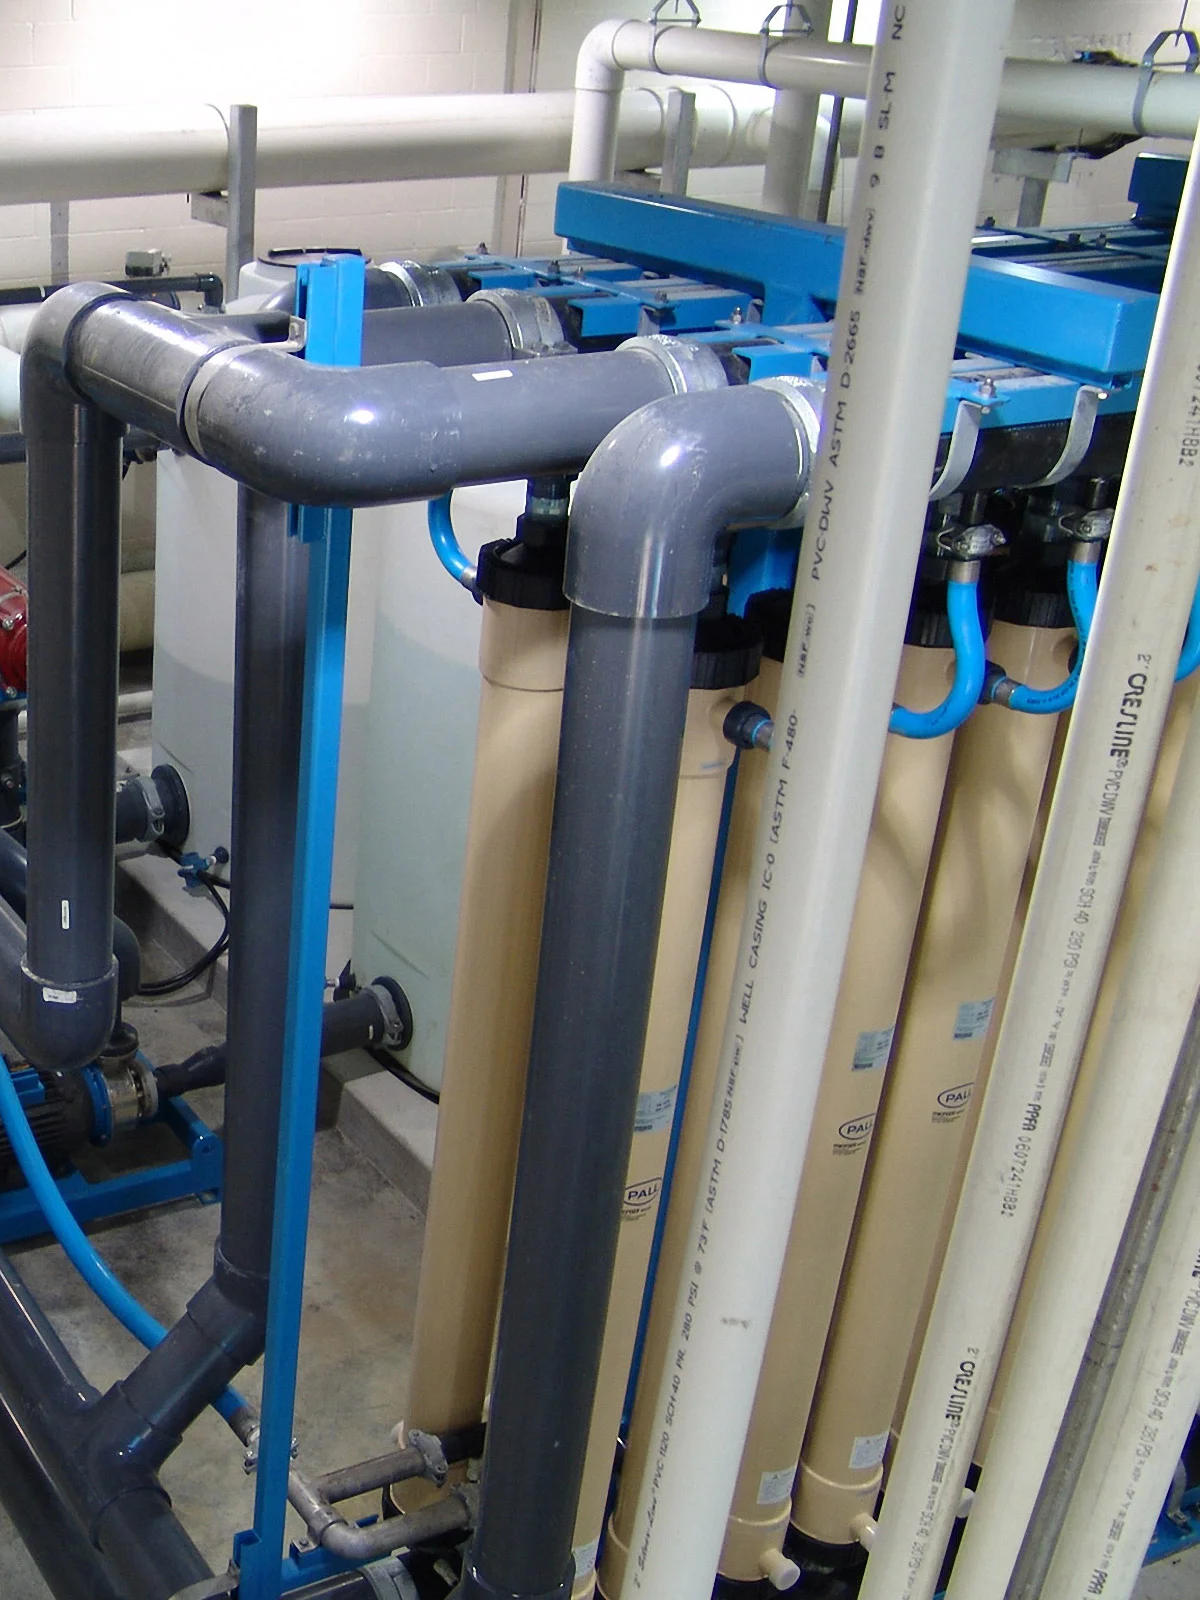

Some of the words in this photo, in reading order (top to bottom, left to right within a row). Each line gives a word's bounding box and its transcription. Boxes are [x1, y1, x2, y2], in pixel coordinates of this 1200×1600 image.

[681, 1312, 692, 1341] 280
[687, 1280, 698, 1307] PSI
[738, 980, 753, 1024] WELL
[748, 899, 767, 968] CASING
[811, 479, 833, 580] PVC-DWV
[828, 400, 846, 467] ASTM
[839, 310, 859, 389] D-2665
[1076, 887, 1095, 908] SCH
[1073, 910, 1089, 924] 40
